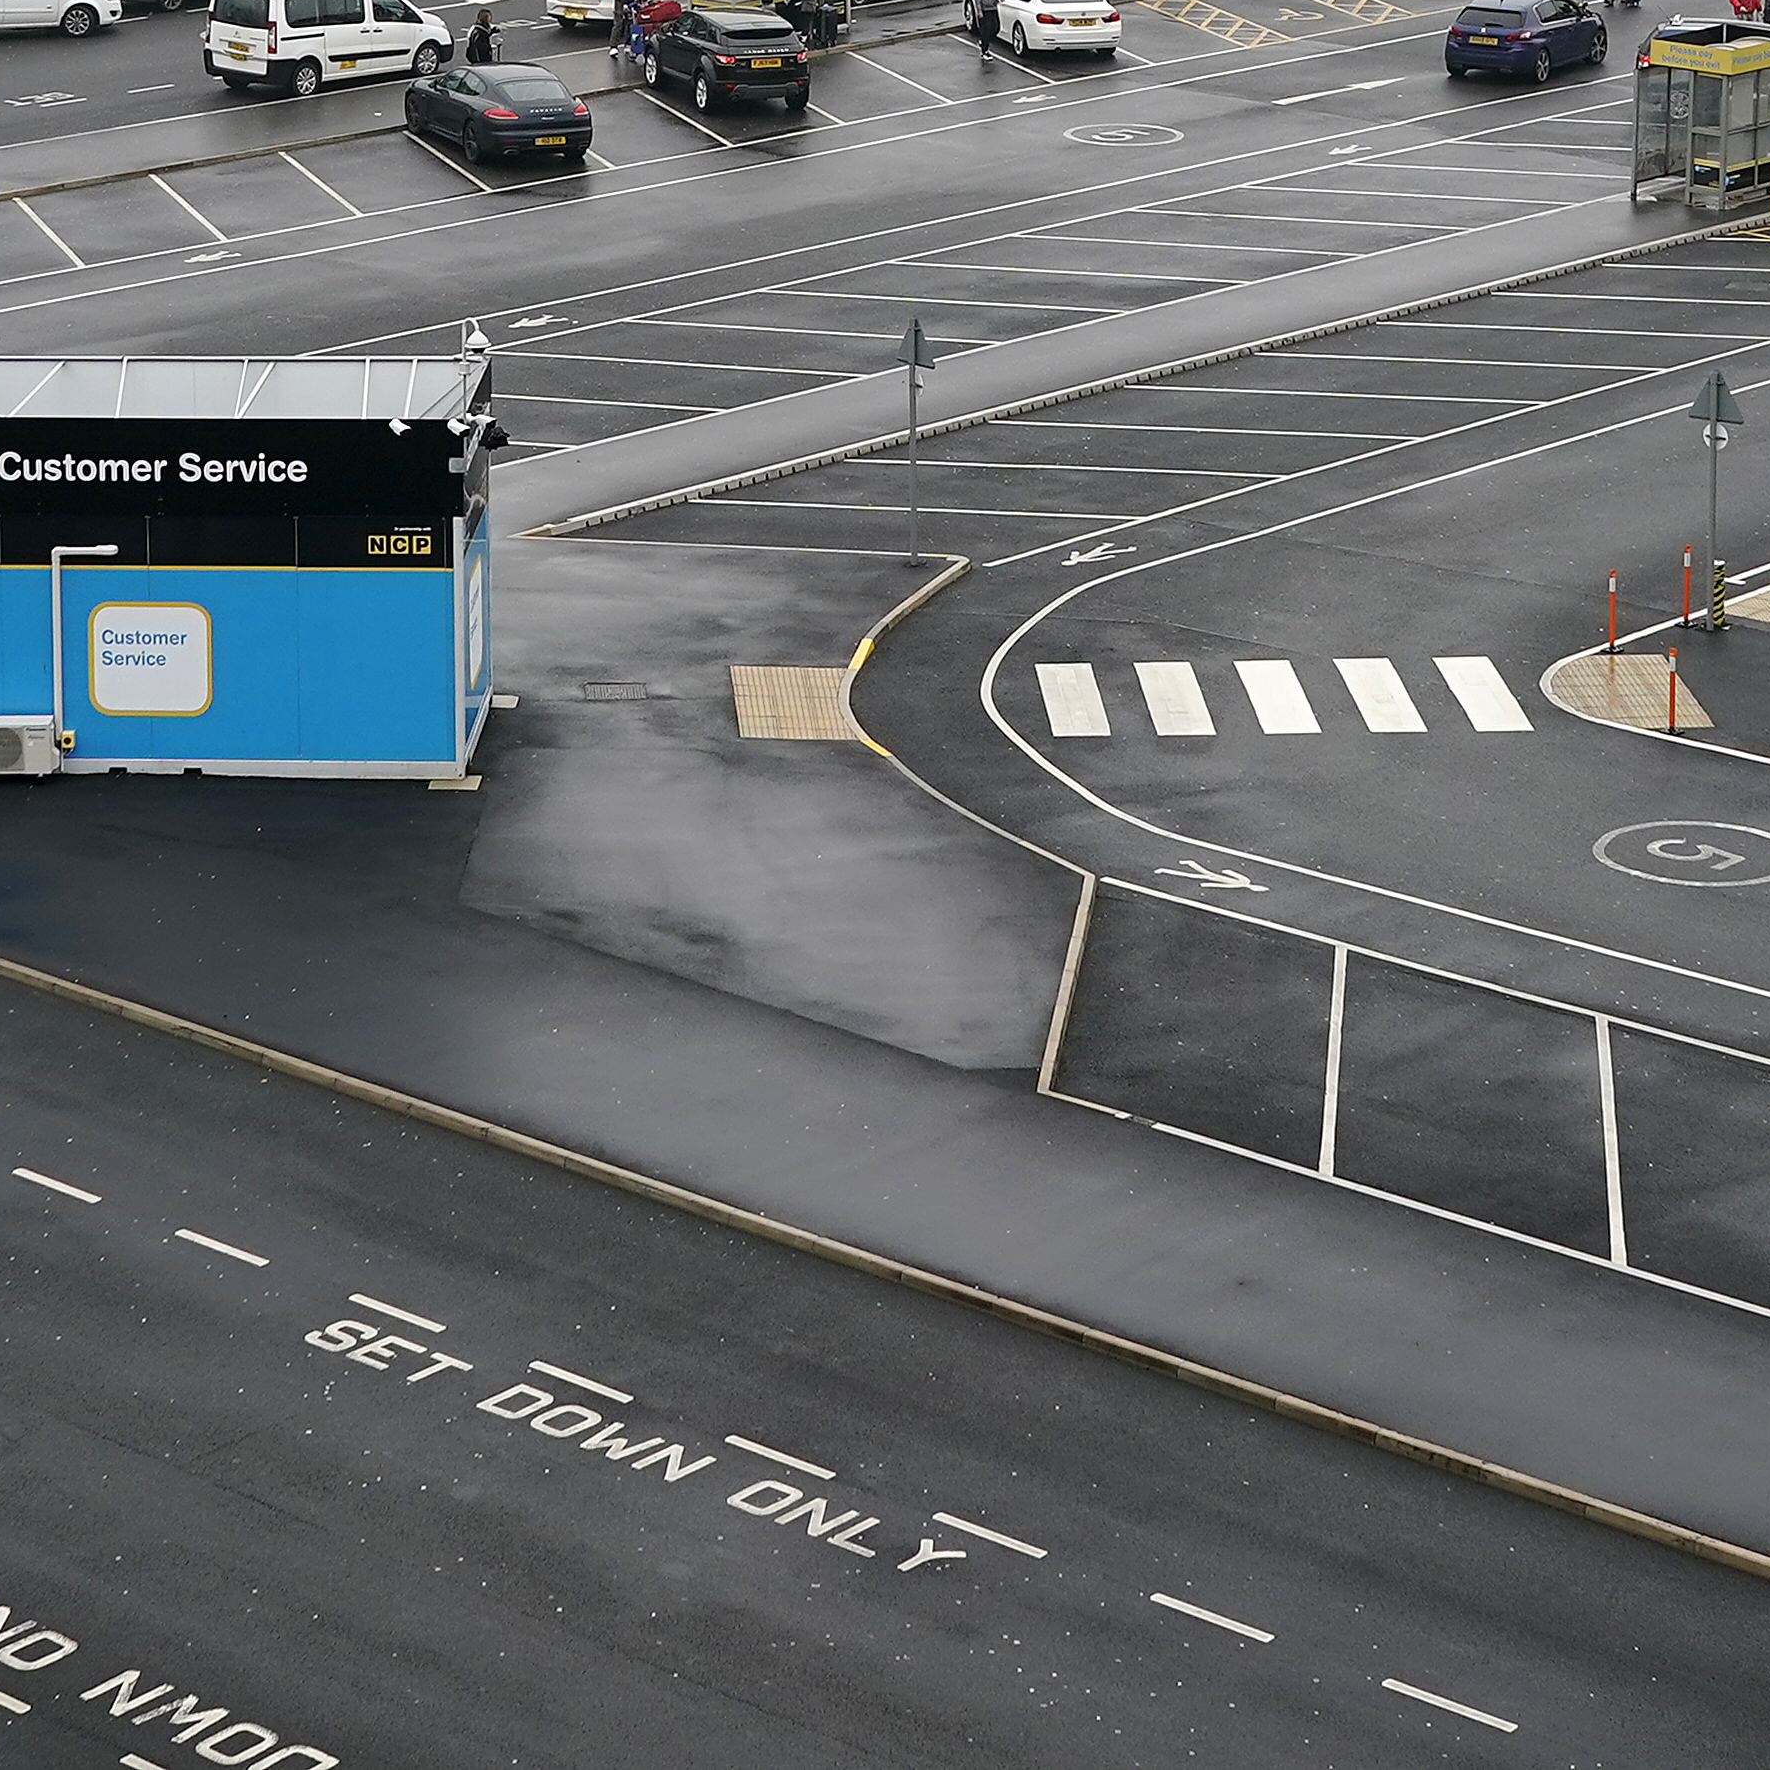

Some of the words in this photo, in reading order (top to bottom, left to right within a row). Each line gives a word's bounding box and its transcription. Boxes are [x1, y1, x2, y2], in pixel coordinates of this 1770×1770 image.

[1661, 54, 1688, 64] before
[1690, 58, 1705, 68] you
[1706, 60, 1720, 69] exit
[1669, 45, 1697, 55] Please
[1698, 50, 1713, 60] pay
[179, 451, 308, 482] Service
[368, 535, 431, 554] NCP
[101, 629, 187, 646] Customer
[101, 650, 166, 666] Service
[1647, 836, 1746, 871] 5
[306, 1318, 472, 1385] SET
[476, 1381, 714, 1482] DOWN
[727, 1479, 966, 1570] ONLY
